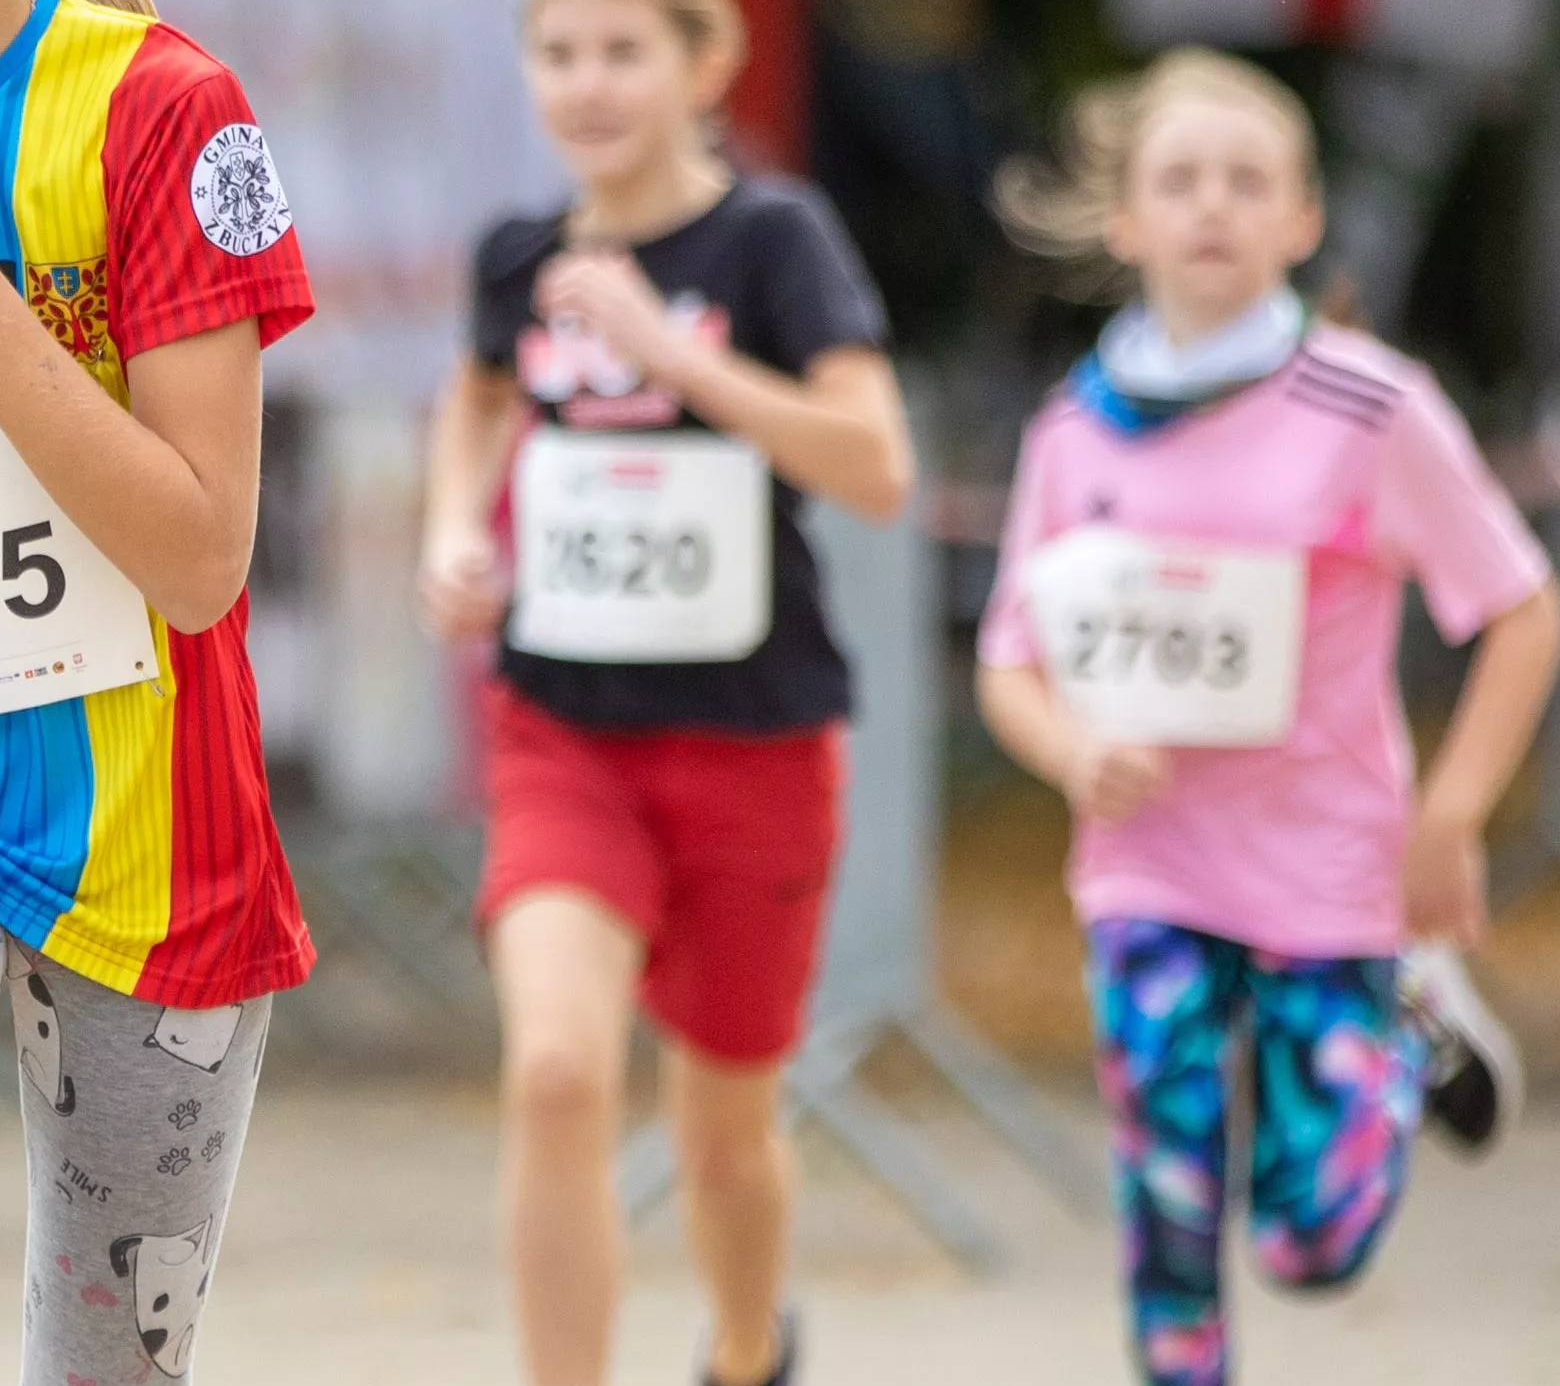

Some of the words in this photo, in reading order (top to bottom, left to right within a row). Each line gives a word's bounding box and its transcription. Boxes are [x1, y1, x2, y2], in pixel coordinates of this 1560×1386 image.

[203, 126, 264, 165] GMINA
[204, 202, 292, 255] ZBUCZYN
[60, 1157, 112, 1203] SMILE
